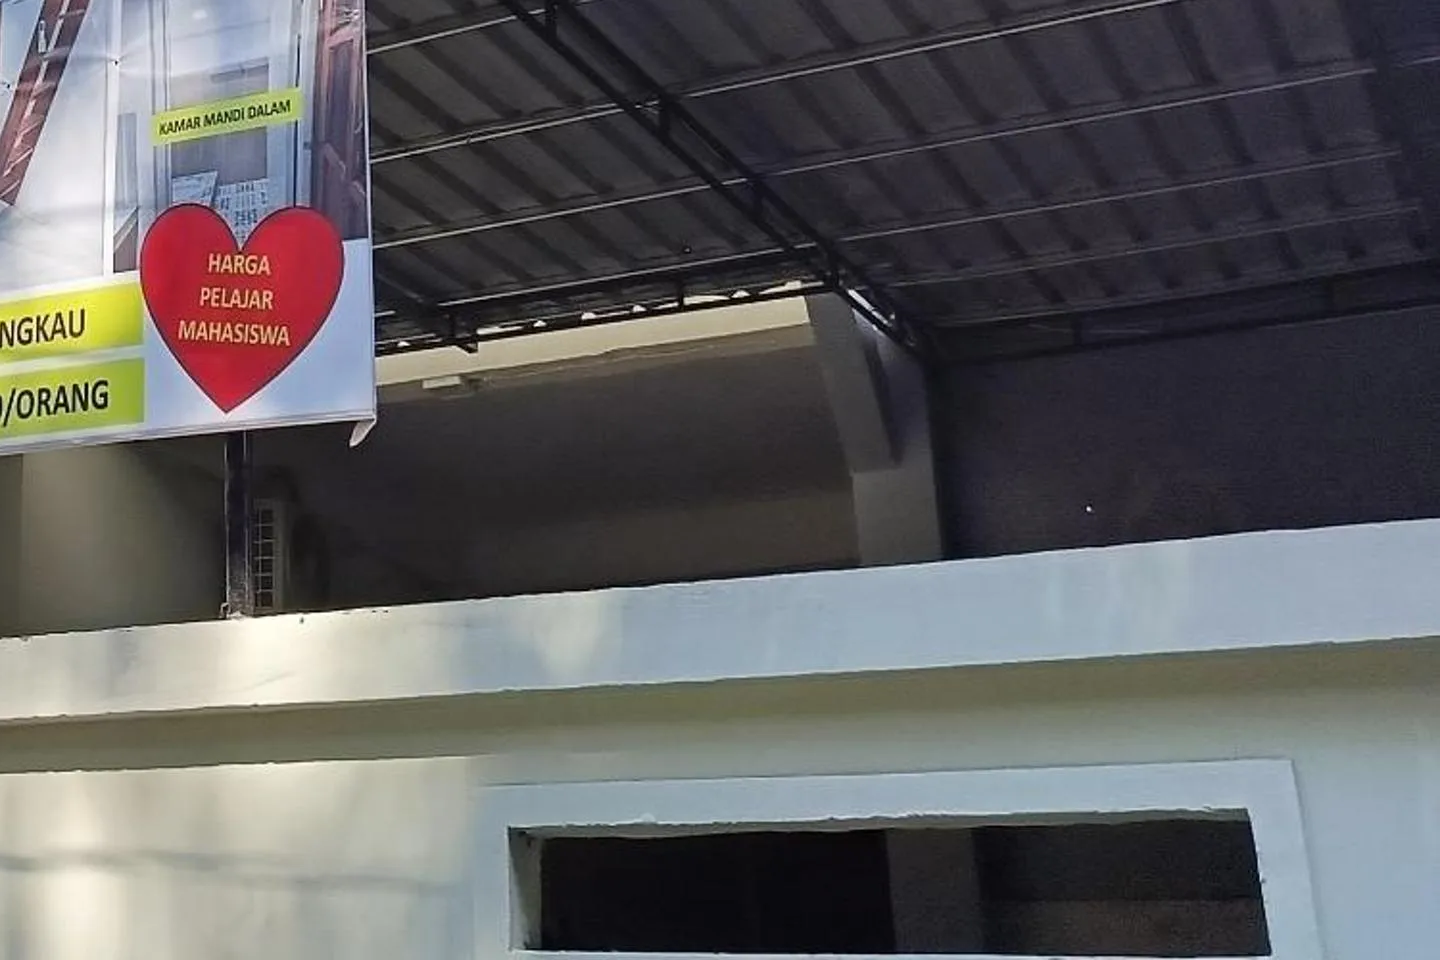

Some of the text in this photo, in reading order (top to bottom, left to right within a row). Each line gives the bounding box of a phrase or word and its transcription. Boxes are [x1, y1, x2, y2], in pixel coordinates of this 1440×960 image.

[159, 99, 291, 135] KAMAR MANDI DALAM
[208, 253, 272, 276] HARGA
[199, 287, 274, 310] PELAJAR
[178, 319, 291, 347] MAHASISWA
